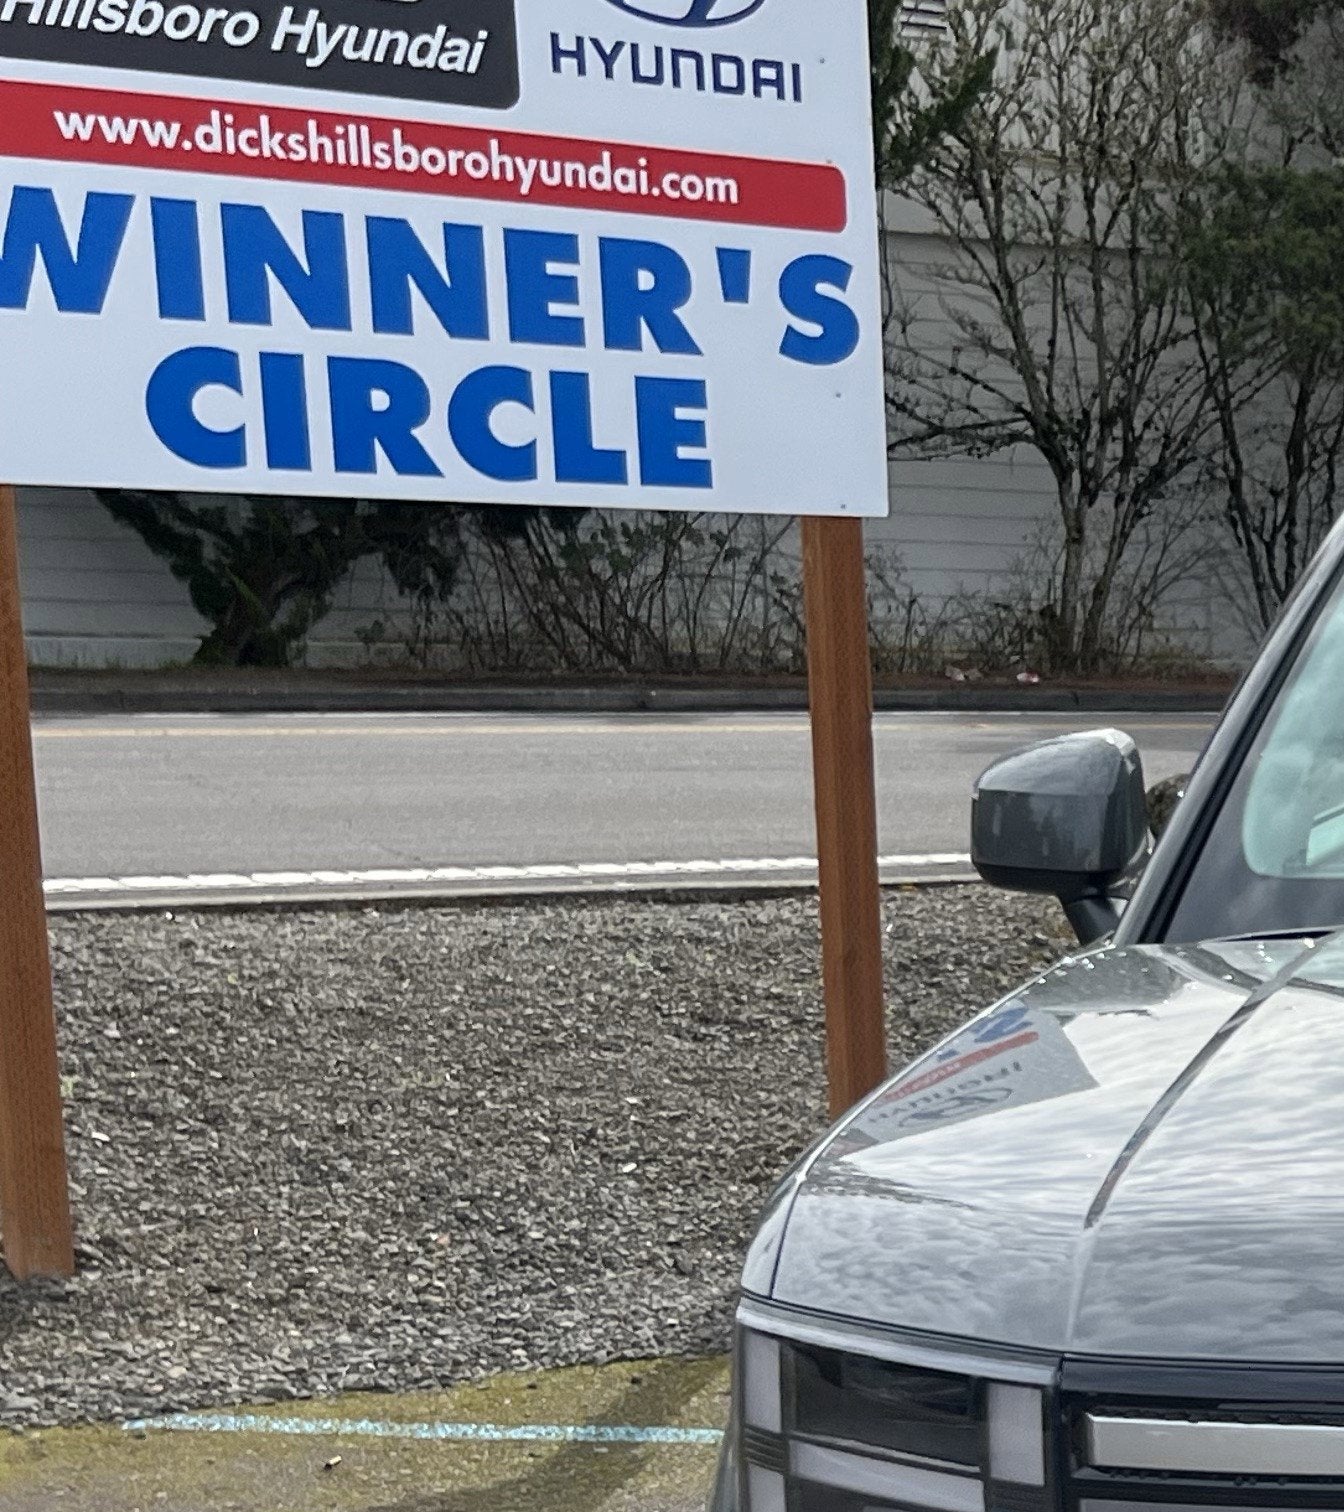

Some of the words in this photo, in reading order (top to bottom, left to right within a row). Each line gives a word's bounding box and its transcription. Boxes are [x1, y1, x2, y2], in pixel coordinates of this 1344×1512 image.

[272, 14, 489, 76] Hyundai
[550, 31, 803, 104] HYUNDAI
[53, 108, 740, 206] www.dickshillsborohyundai.com
[0, 184, 861, 367] WINNER'S
[144, 345, 714, 490] CIRCLE
